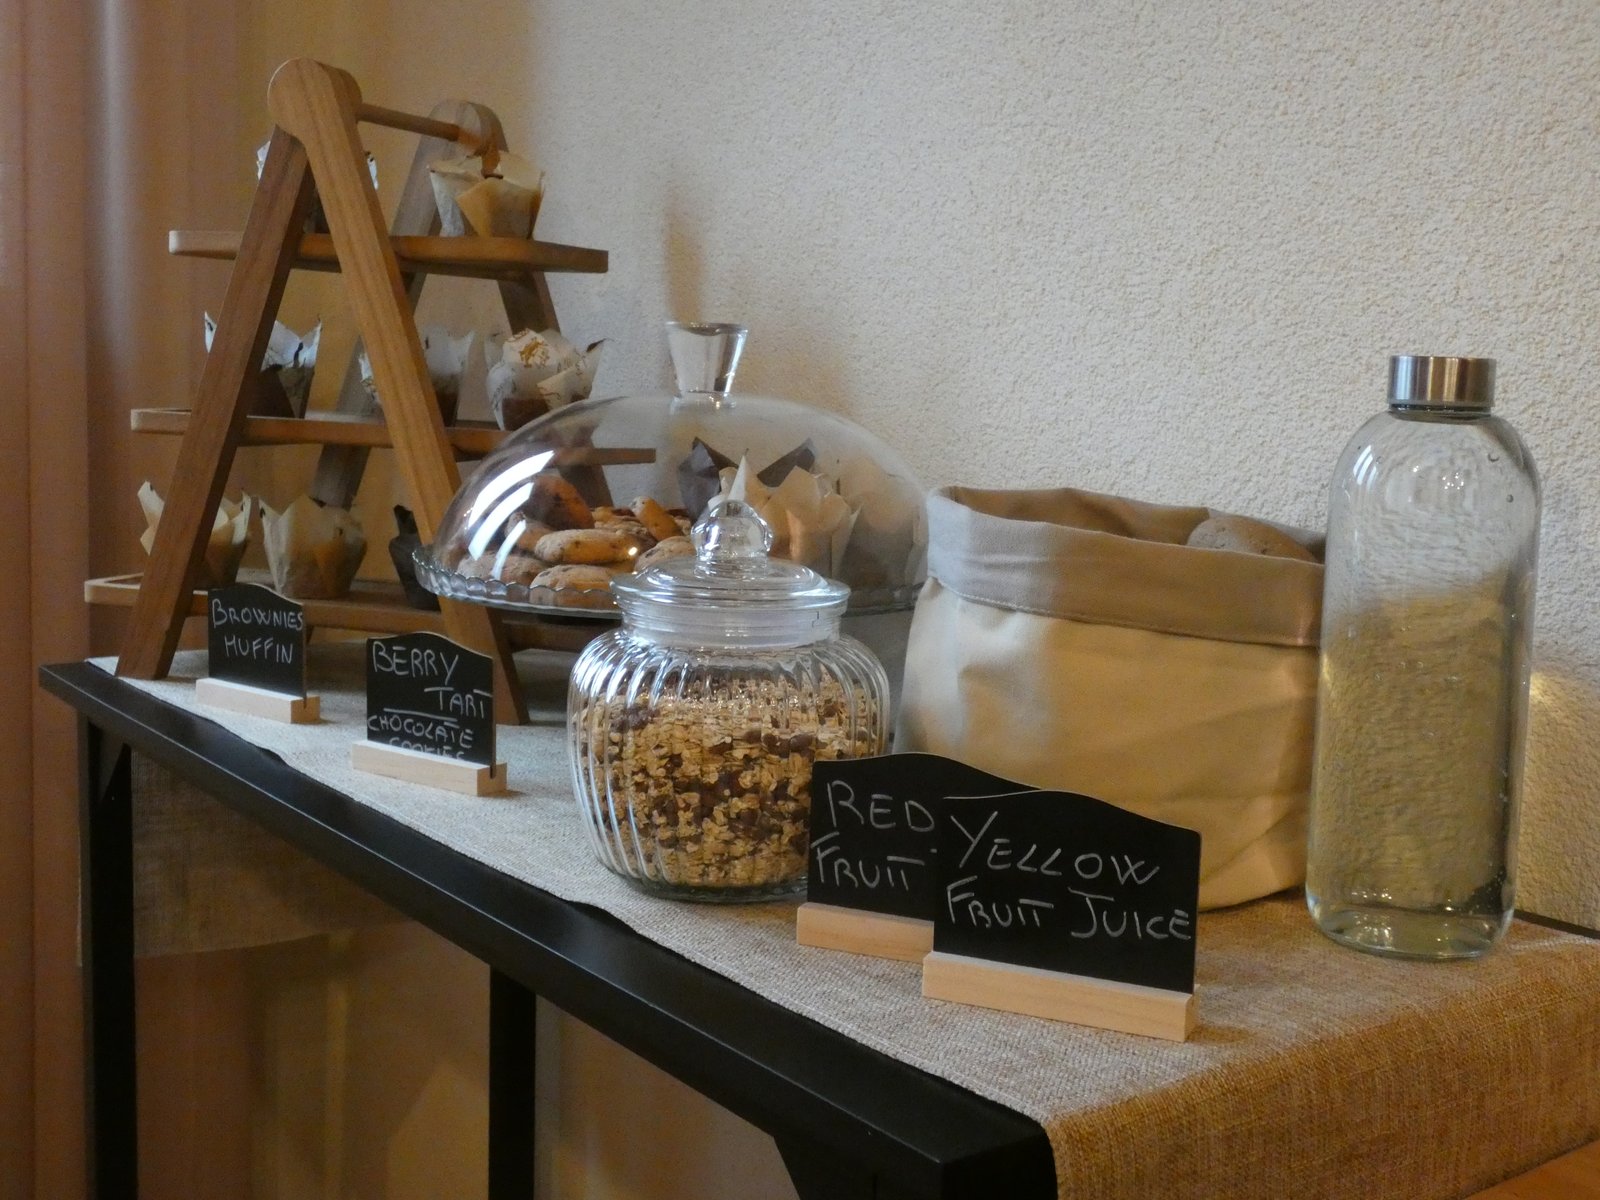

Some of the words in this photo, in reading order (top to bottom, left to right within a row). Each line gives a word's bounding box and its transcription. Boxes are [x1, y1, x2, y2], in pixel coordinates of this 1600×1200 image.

[211, 598, 303, 631] BROWNIES
[372, 640, 459, 685] BERRY
[423, 686, 493, 718] TART
[367, 714, 474, 749] CHOCOLATE
[826, 780, 935, 832] RED
[810, 831, 925, 891] FRUIT
[950, 811, 1160, 885] YELLOW
[947, 875, 1054, 929] FRUIT
[1067, 886, 1192, 940] JUICE
